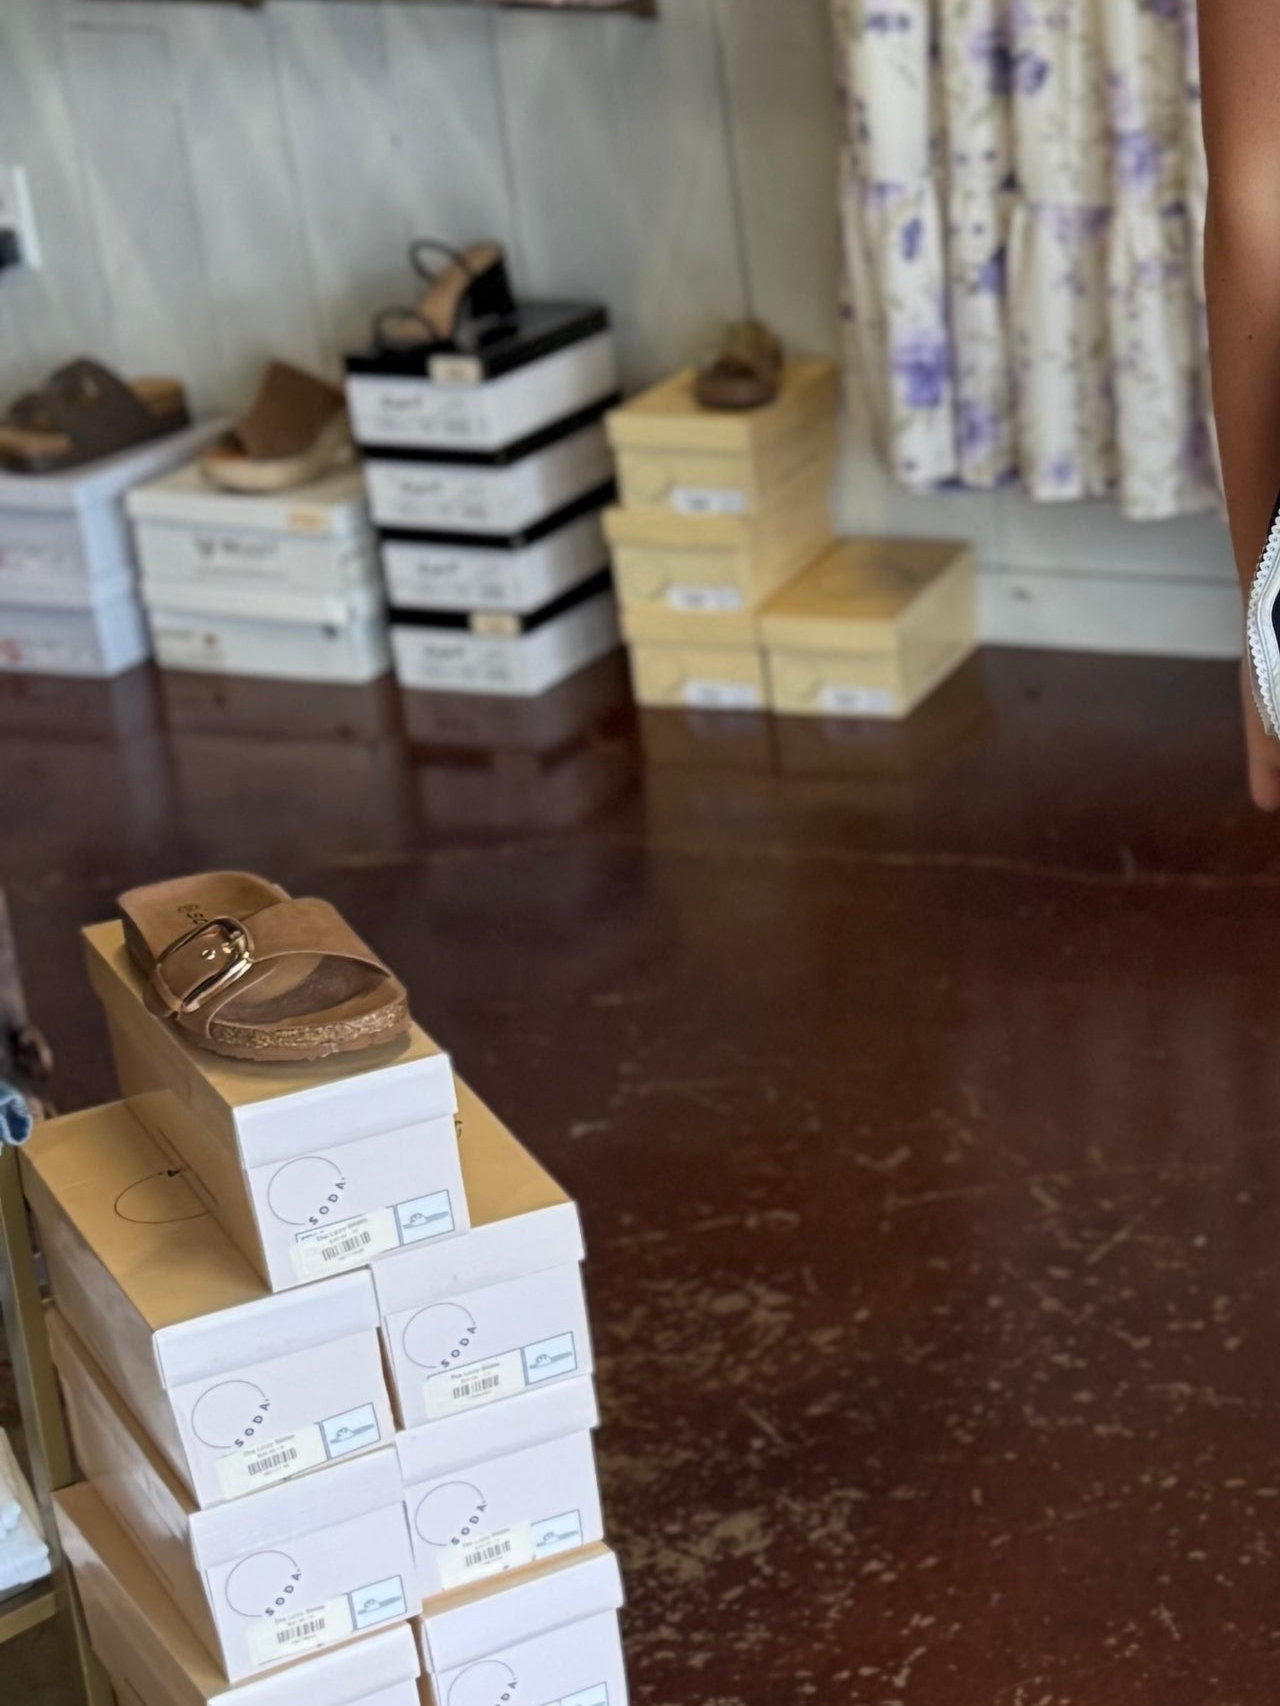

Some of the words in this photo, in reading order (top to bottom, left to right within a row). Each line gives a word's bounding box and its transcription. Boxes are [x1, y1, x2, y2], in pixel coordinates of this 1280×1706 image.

[308, 1180, 346, 1225] SODA
[441, 1326, 477, 1368] SODA
[234, 1400, 271, 1447] SODA
[451, 1503, 487, 1545] SODA
[265, 1572, 302, 1616] SODA
